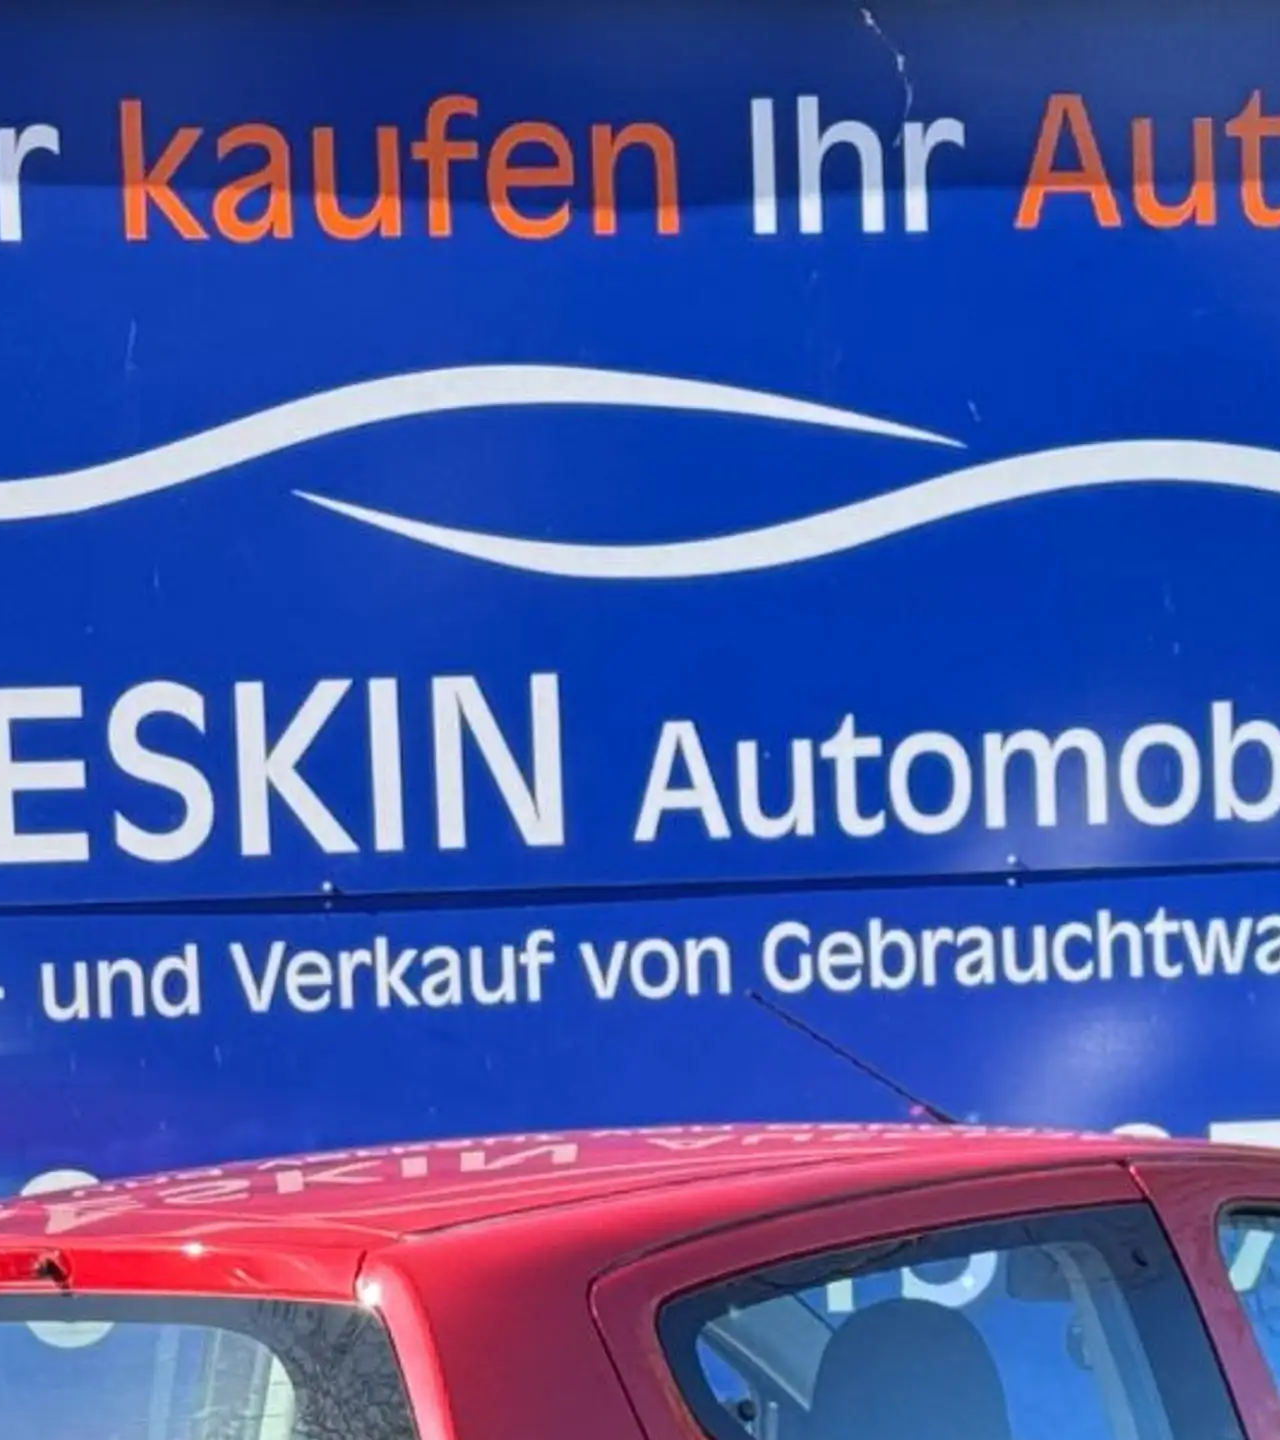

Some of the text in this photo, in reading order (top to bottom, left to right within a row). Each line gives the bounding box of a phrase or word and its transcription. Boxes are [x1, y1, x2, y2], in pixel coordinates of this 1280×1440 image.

[121, 97, 680, 243] kaufen
[751, 96, 964, 234] Ihr
[41, 943, 200, 1021] und
[230, 929, 555, 1012] Verkauf
[580, 937, 731, 999] von
